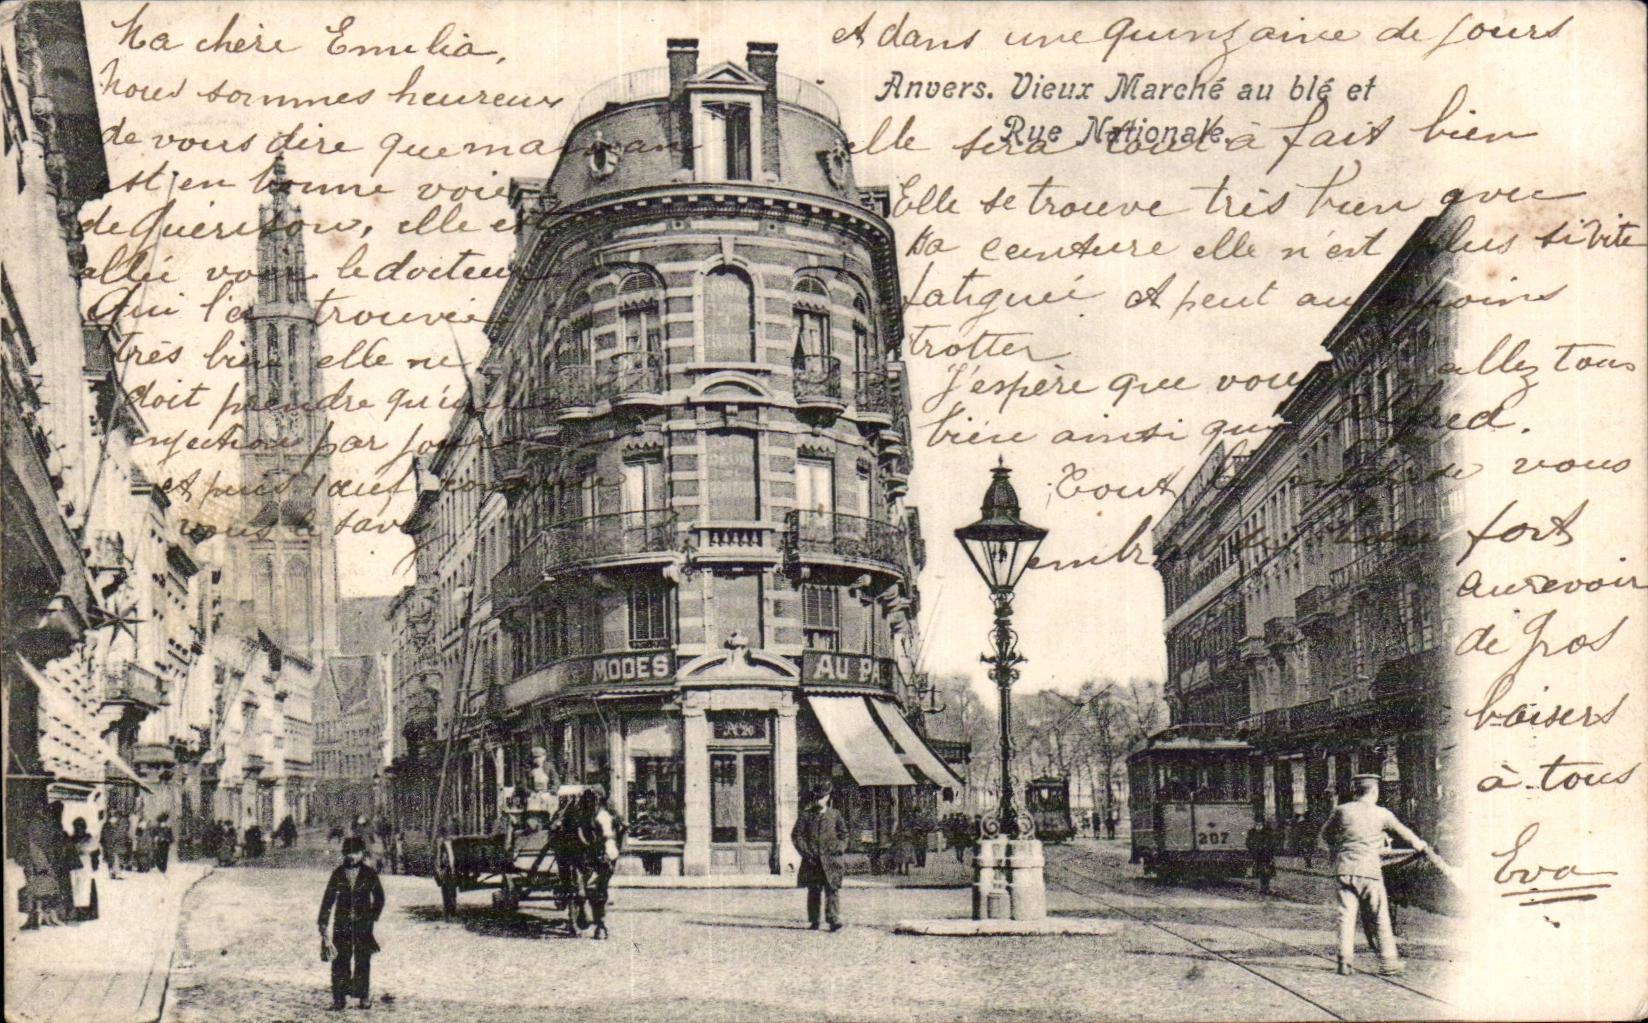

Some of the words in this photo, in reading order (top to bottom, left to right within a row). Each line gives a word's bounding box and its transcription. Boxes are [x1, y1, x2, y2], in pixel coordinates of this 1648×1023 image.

[878, 12, 982, 50] dans
[1004, 30, 1100, 47] une
[1376, 16, 1432, 42] de
[197, 79, 375, 109] sommes
[1409, 83, 1539, 143] bien
[101, 117, 142, 145] de
[153, 133, 257, 151] vous
[266, 122, 364, 154] dire
[893, 173, 960, 218] Elle
[980, 187, 1017, 214] se
[1027, 175, 1192, 217] trouve
[1440, 187, 1588, 205] avec
[398, 206, 481, 234] elle
[1193, 226, 1257, 260] elle
[1170, 280, 1279, 320] peut
[316, 336, 393, 368] elle
[908, 325, 1072, 362] trotter
[1108, 373, 1201, 407] que
[1512, 457, 1632, 474] vous
[1455, 624, 1509, 655] de
[592, 653, 669, 681] MODES
[813, 654, 849, 680] AU
[1540, 754, 1642, 791] tous
[1491, 822, 1619, 884] Eva
